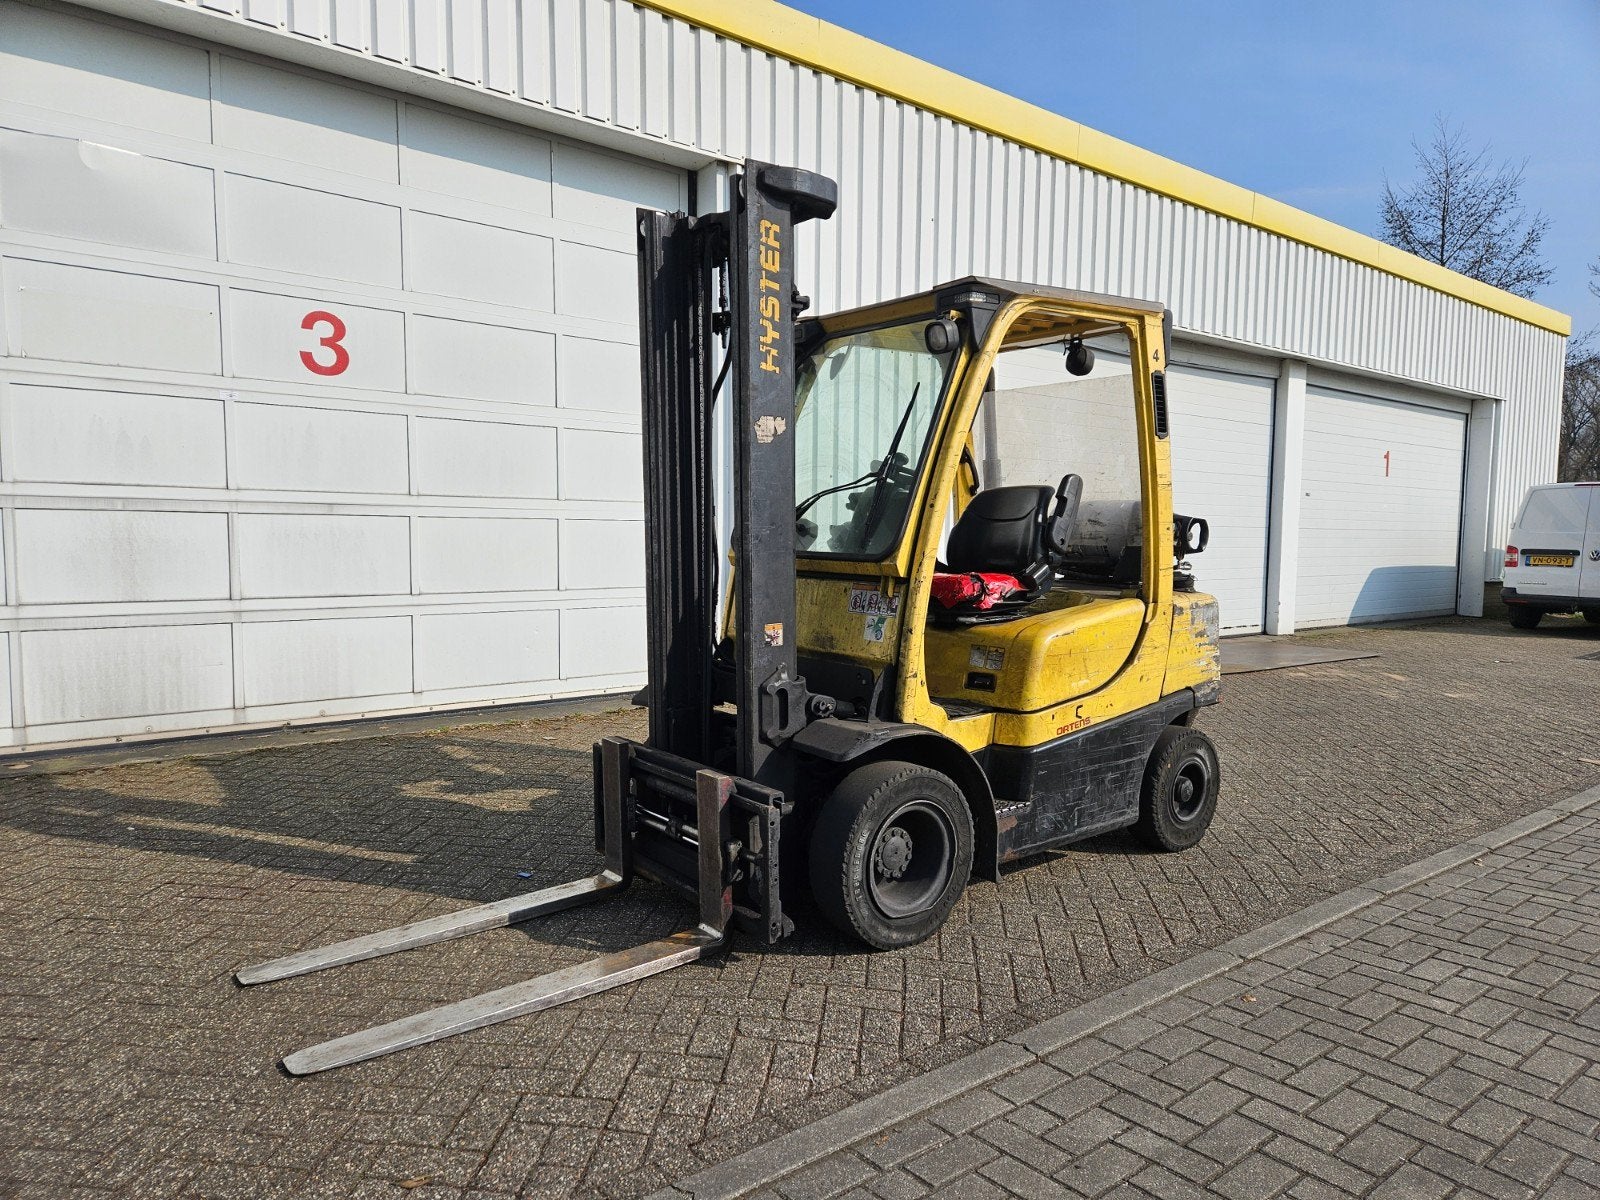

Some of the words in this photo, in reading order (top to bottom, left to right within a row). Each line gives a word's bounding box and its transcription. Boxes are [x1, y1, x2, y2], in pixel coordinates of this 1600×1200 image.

[760, 218, 780, 374] HYSTER
[299, 310, 350, 376] 3
[1152, 348, 1160, 363] 4
[1383, 450, 1390, 477] 1
[1532, 556, 1570, 565] VN-093-T
